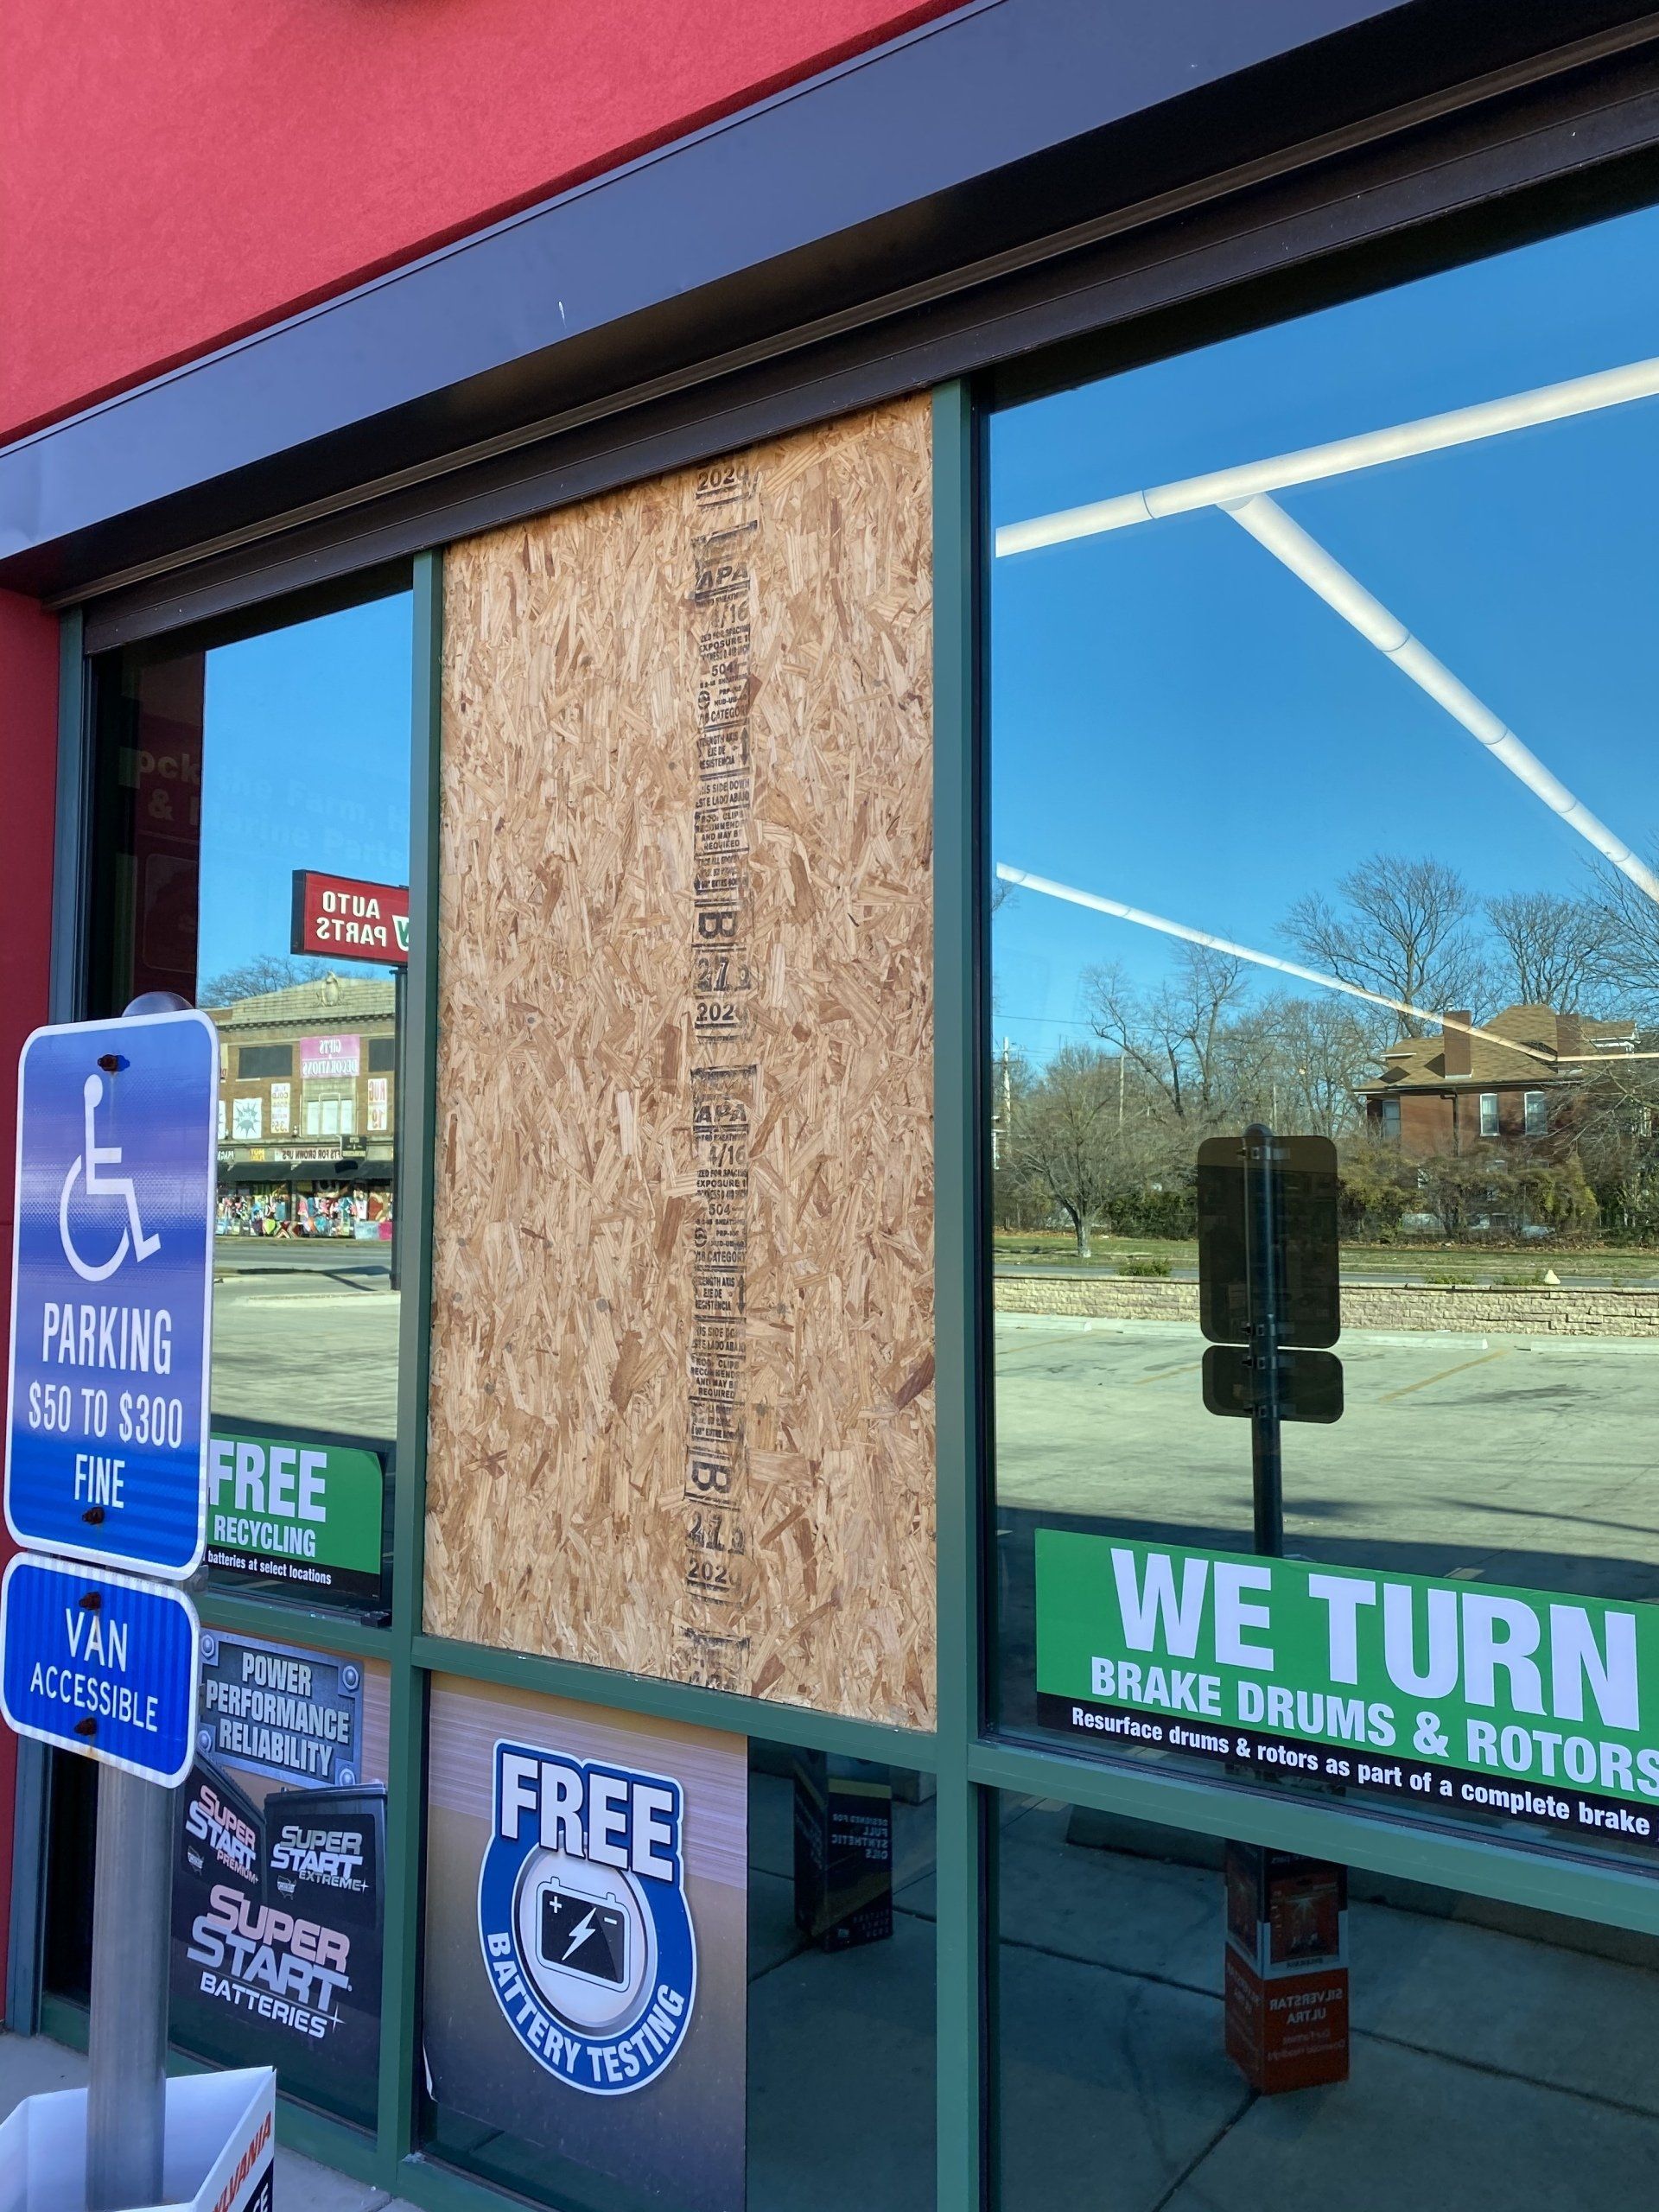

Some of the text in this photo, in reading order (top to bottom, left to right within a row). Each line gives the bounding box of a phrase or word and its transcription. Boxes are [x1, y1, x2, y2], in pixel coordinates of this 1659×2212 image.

[42, 1302, 171, 1375] PARKING
[28, 1380, 182, 1449] $50 TO $300
[698, 1388, 734, 1398] REQUIRED
[74, 1453, 125, 1509] FINE
[210, 1439, 327, 1522] FREE
[207, 1549, 332, 1586] batteries at select locations
[213, 1515, 316, 1557] RECYCLING
[66, 1608, 128, 1672] VAN
[242, 1651, 312, 1697] POWER
[1110, 1548, 1640, 1732] WE TURN
[30, 1662, 159, 1732] ACCESSIBLE
[206, 1679, 349, 1744] PERFORMANCE
[1091, 1656, 1659, 1797] BRAKE DRUMS & ROTORS
[219, 1718, 333, 1777] RELIABILITY
[1072, 1707, 1163, 1741] Resurface
[1169, 1726, 1230, 1754] drums
[1236, 1738, 1251, 1758] &
[1257, 1744, 1319, 1770] rotors
[1325, 1757, 1351, 1777] as
[1357, 1763, 1402, 1787] part
[1409, 1772, 1432, 1793] of
[1440, 1780, 1452, 1796] a
[1461, 1783, 1570, 1820] complete
[1579, 1802, 1650, 1836] brake
[185, 1800, 256, 1871] START
[199, 1784, 257, 1851] SUPER
[280, 1825, 363, 1855] SUPER
[501, 1751, 674, 1882] FREE
[270, 1843, 363, 1880] START
[207, 1884, 350, 1974] SUPER
[187, 1915, 349, 2012] START
[200, 1971, 327, 2038] BATTERIES
[487, 1931, 684, 2083] BATTERY TESTING
